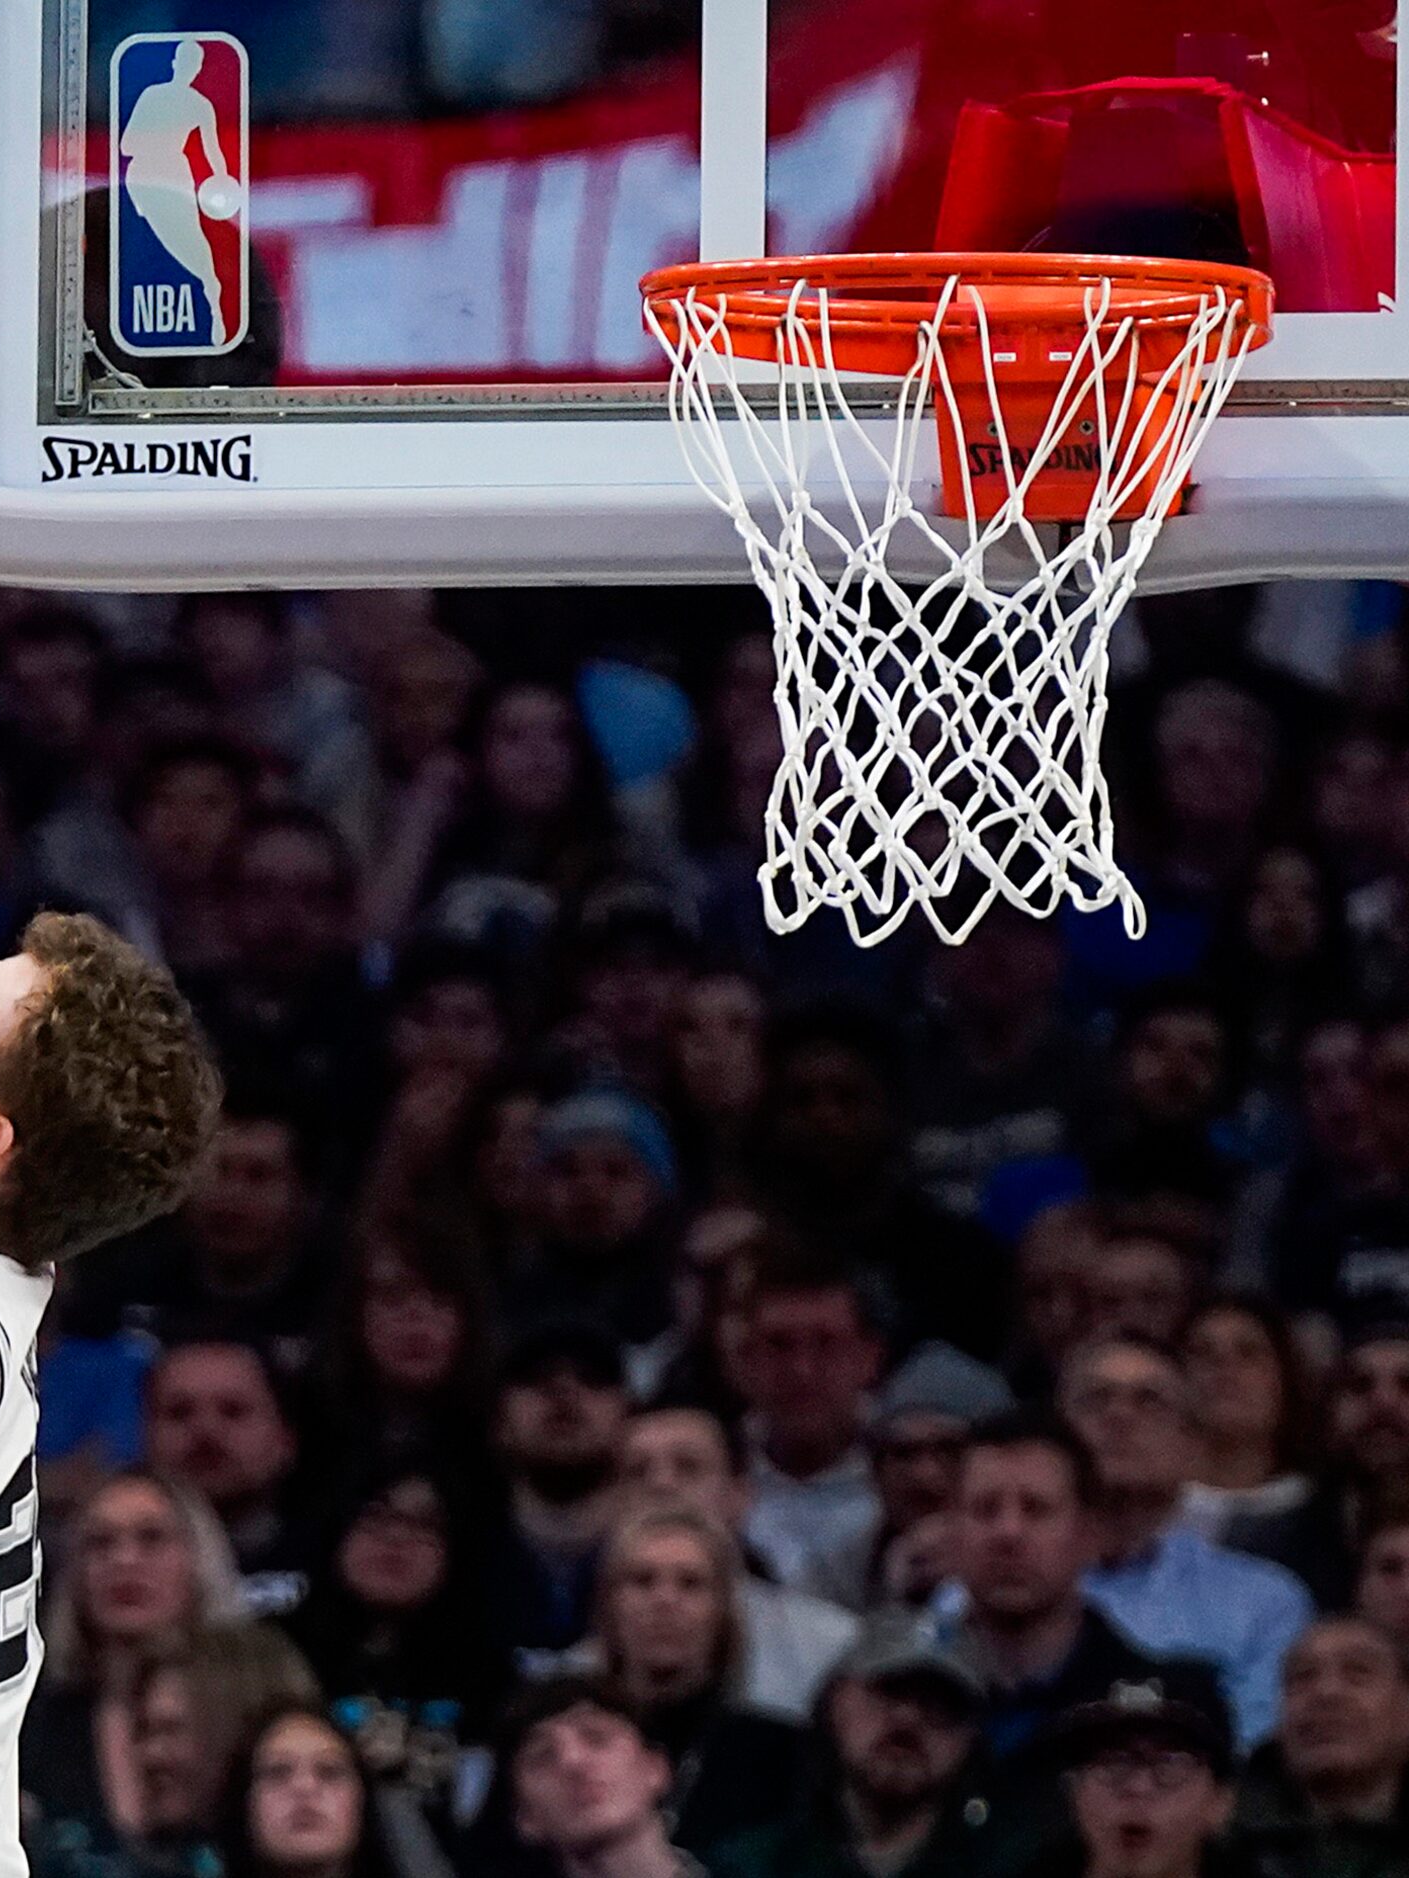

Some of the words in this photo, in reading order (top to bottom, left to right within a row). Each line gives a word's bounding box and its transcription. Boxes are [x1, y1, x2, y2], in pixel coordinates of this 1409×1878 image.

[133, 284, 196, 334] NBA
[42, 434, 252, 483] SPALDING
[969, 442, 1117, 477] SPADIN
